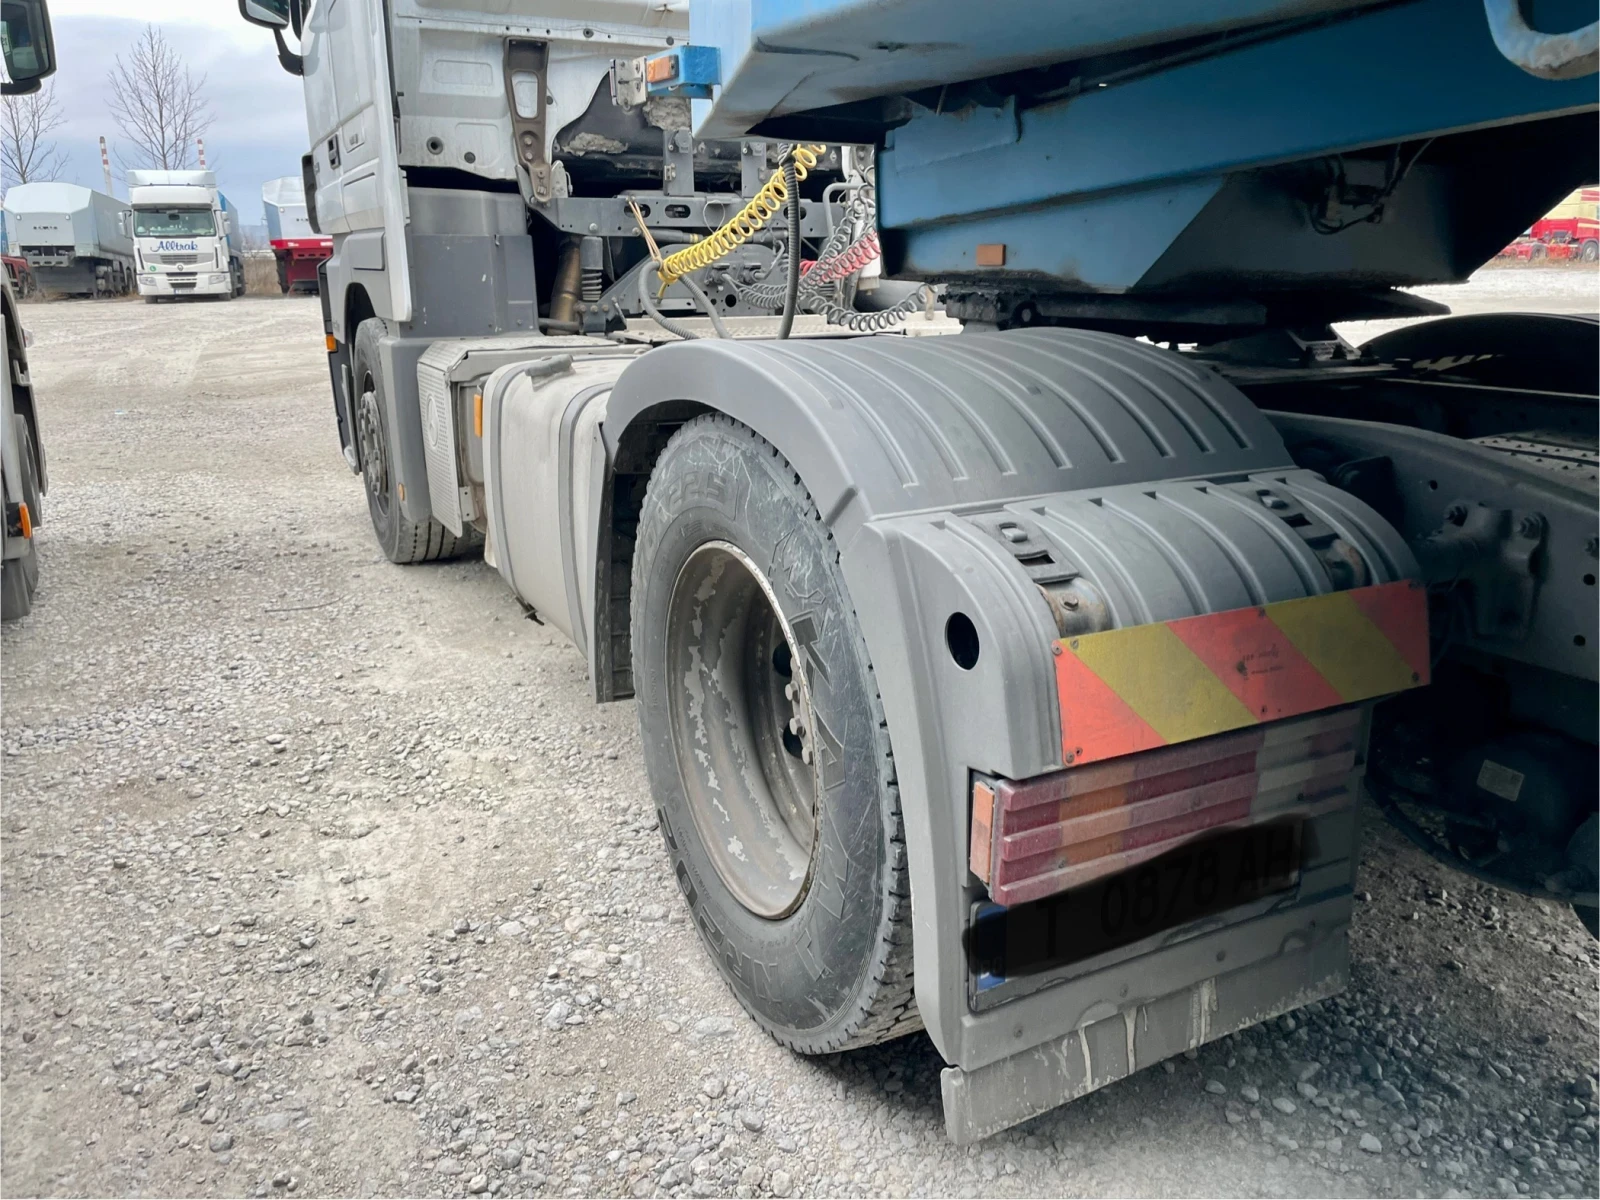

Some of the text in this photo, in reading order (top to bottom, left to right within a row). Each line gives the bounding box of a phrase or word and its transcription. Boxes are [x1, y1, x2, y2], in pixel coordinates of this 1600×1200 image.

[149, 240, 198, 252] Alltrak
[789, 609, 851, 982] KAMA
[657, 806, 783, 1003] NR202
